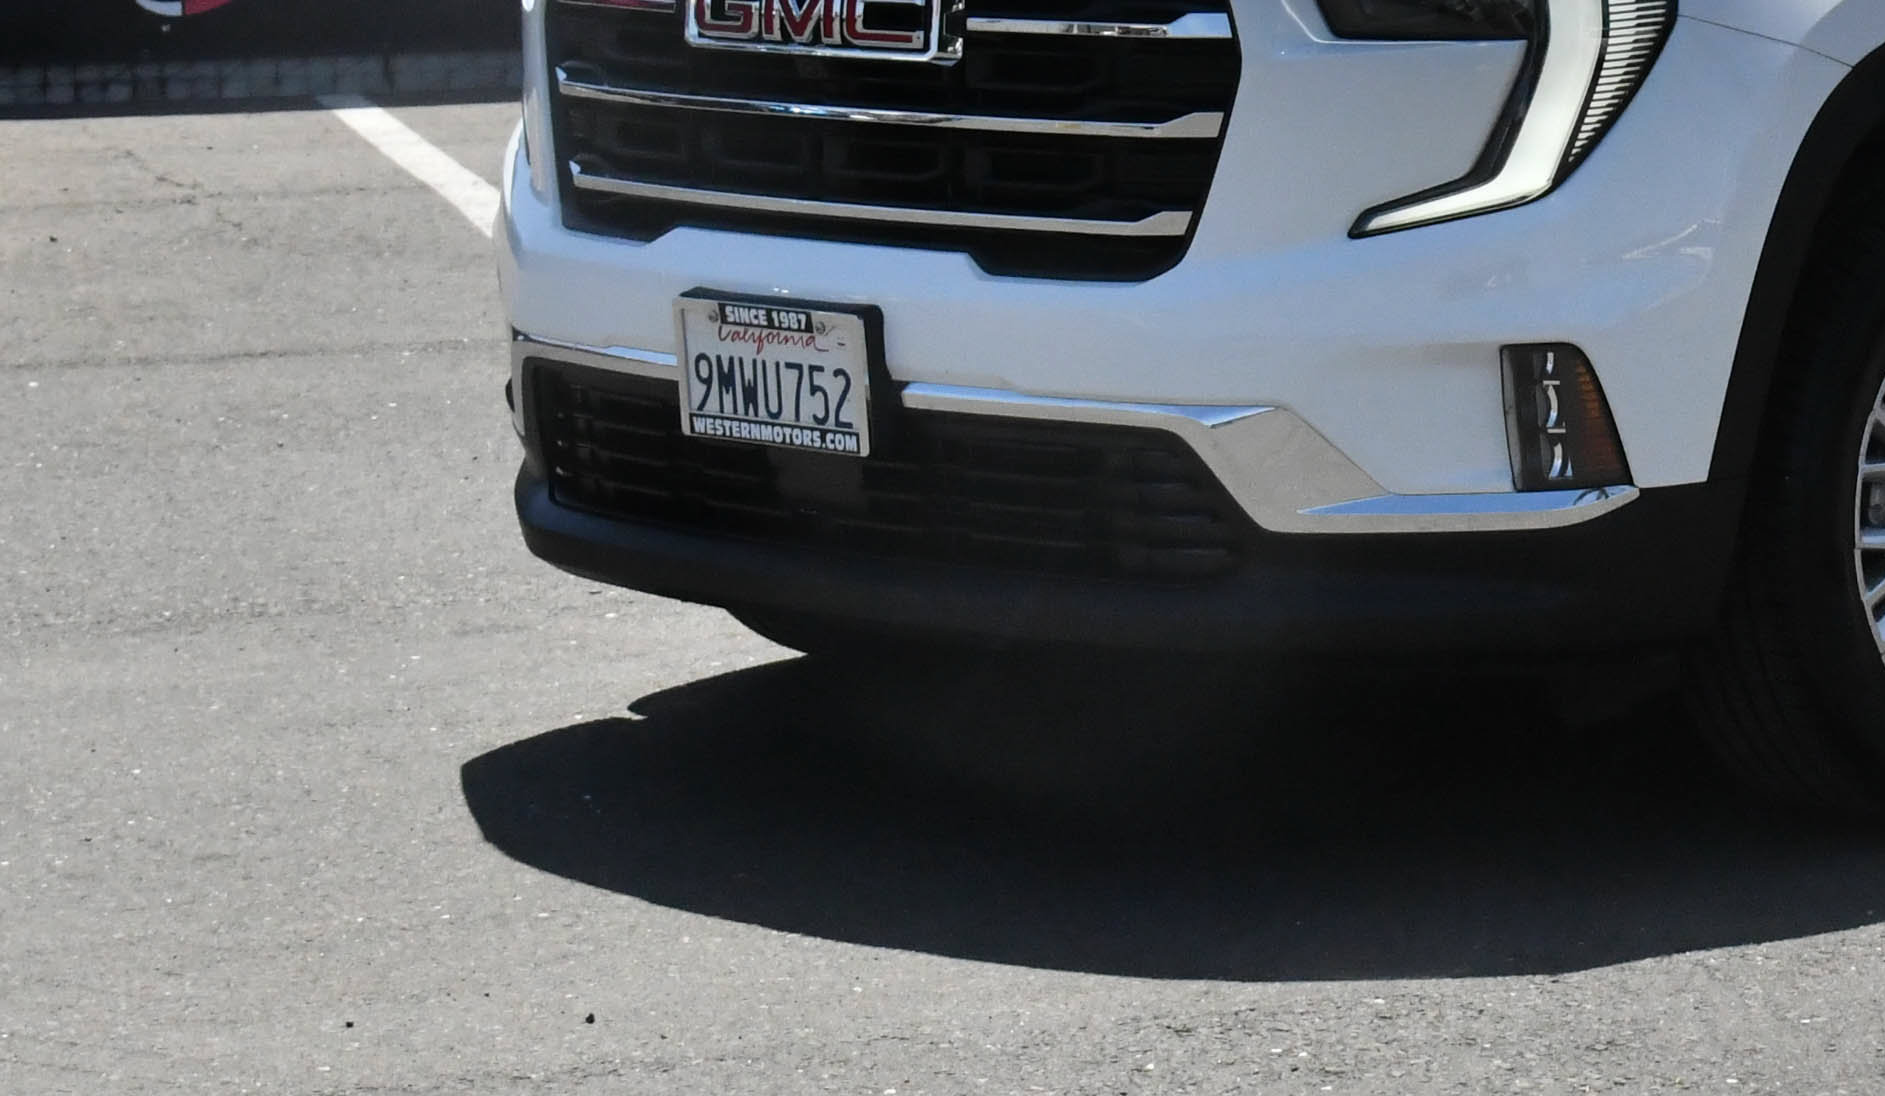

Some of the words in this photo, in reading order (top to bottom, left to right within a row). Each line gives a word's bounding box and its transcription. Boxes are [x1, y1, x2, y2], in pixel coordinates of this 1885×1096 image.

[724, 305, 767, 326] SINCE
[771, 311, 808, 331] 1987
[718, 325, 829, 354] California
[694, 352, 854, 429] 9MWU752
[693, 416, 859, 453] WESTERNMOTORS.COM
